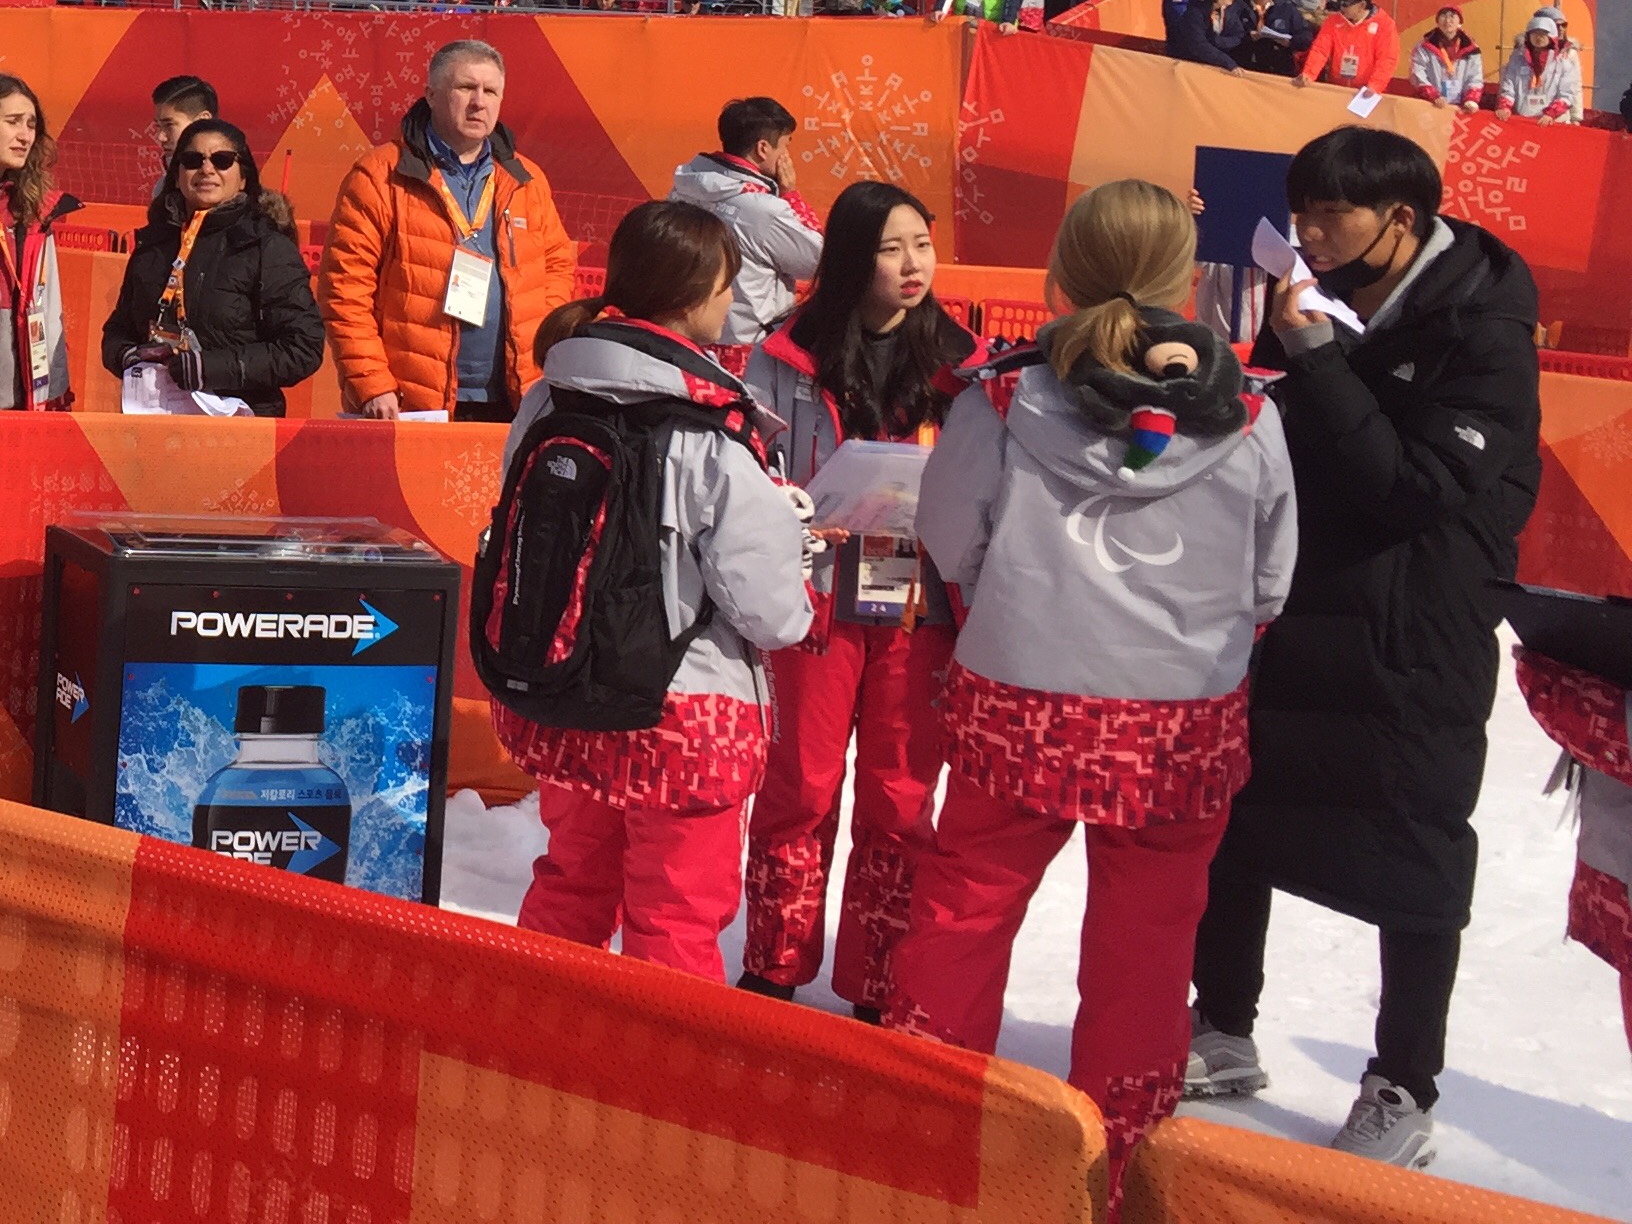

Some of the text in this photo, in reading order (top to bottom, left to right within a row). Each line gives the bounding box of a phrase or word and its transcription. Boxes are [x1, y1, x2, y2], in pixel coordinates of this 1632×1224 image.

[170, 611, 375, 639] POWERADE
[57, 672, 85, 704] POWER
[211, 830, 322, 851] POWER
